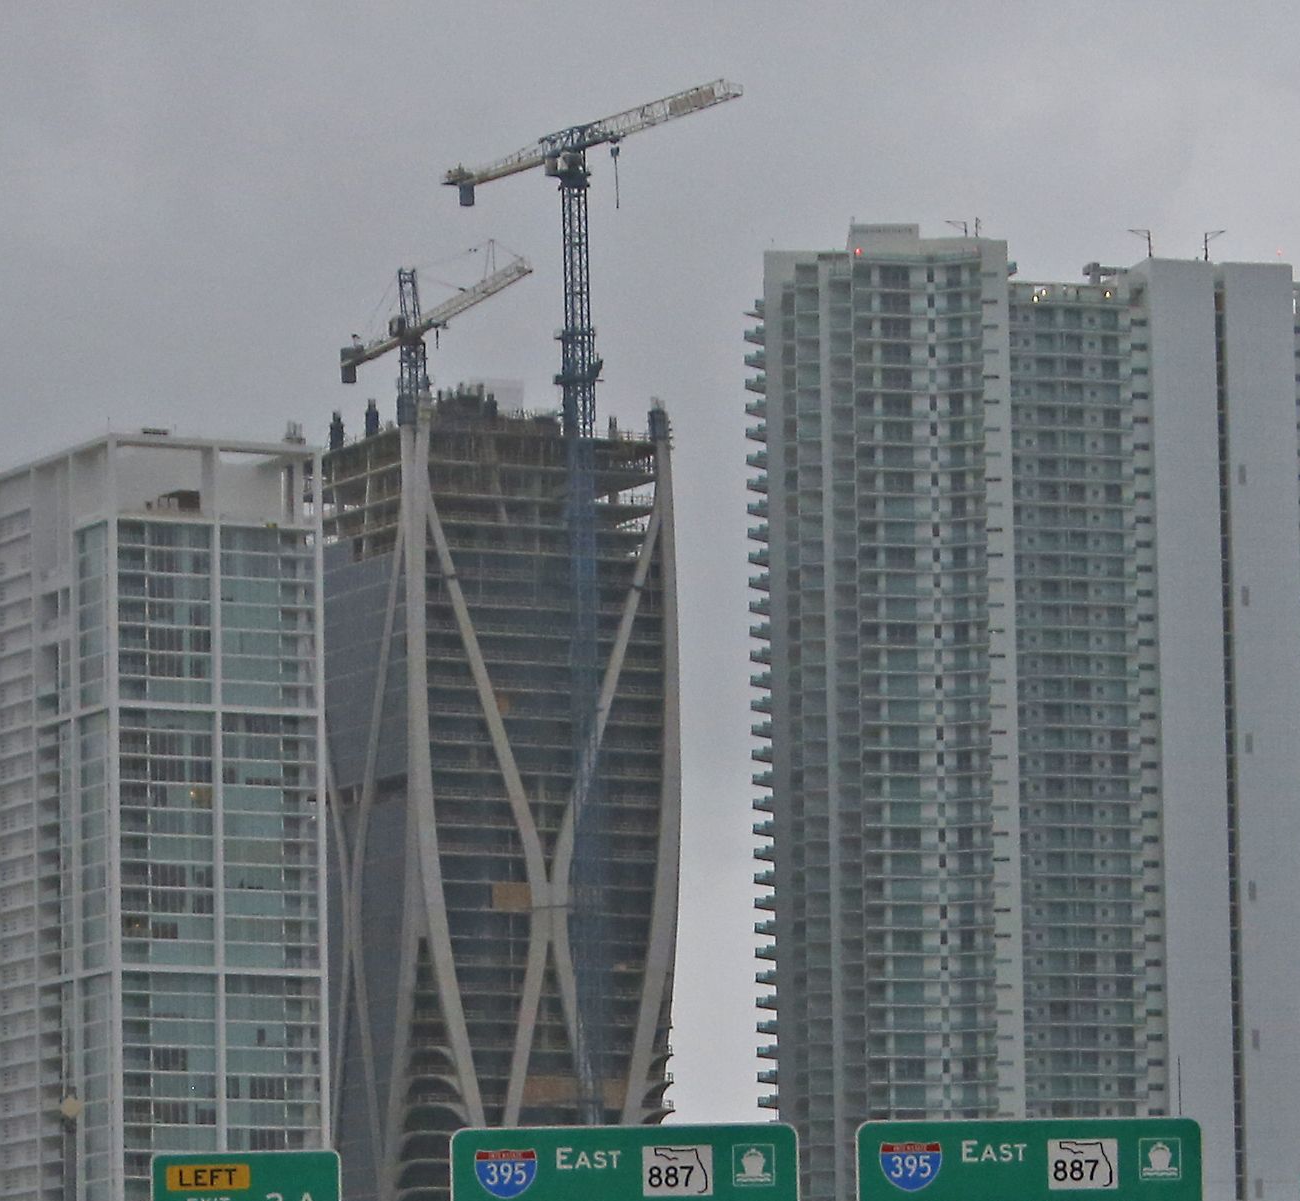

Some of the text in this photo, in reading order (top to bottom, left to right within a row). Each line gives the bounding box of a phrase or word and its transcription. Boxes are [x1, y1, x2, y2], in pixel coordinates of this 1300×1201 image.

[178, 1168, 237, 1187] LEFT
[486, 1162, 527, 1186] 395
[648, 1165, 694, 1188] 887
[891, 1154, 932, 1178] 395
[1053, 1159, 1099, 1182] 887
